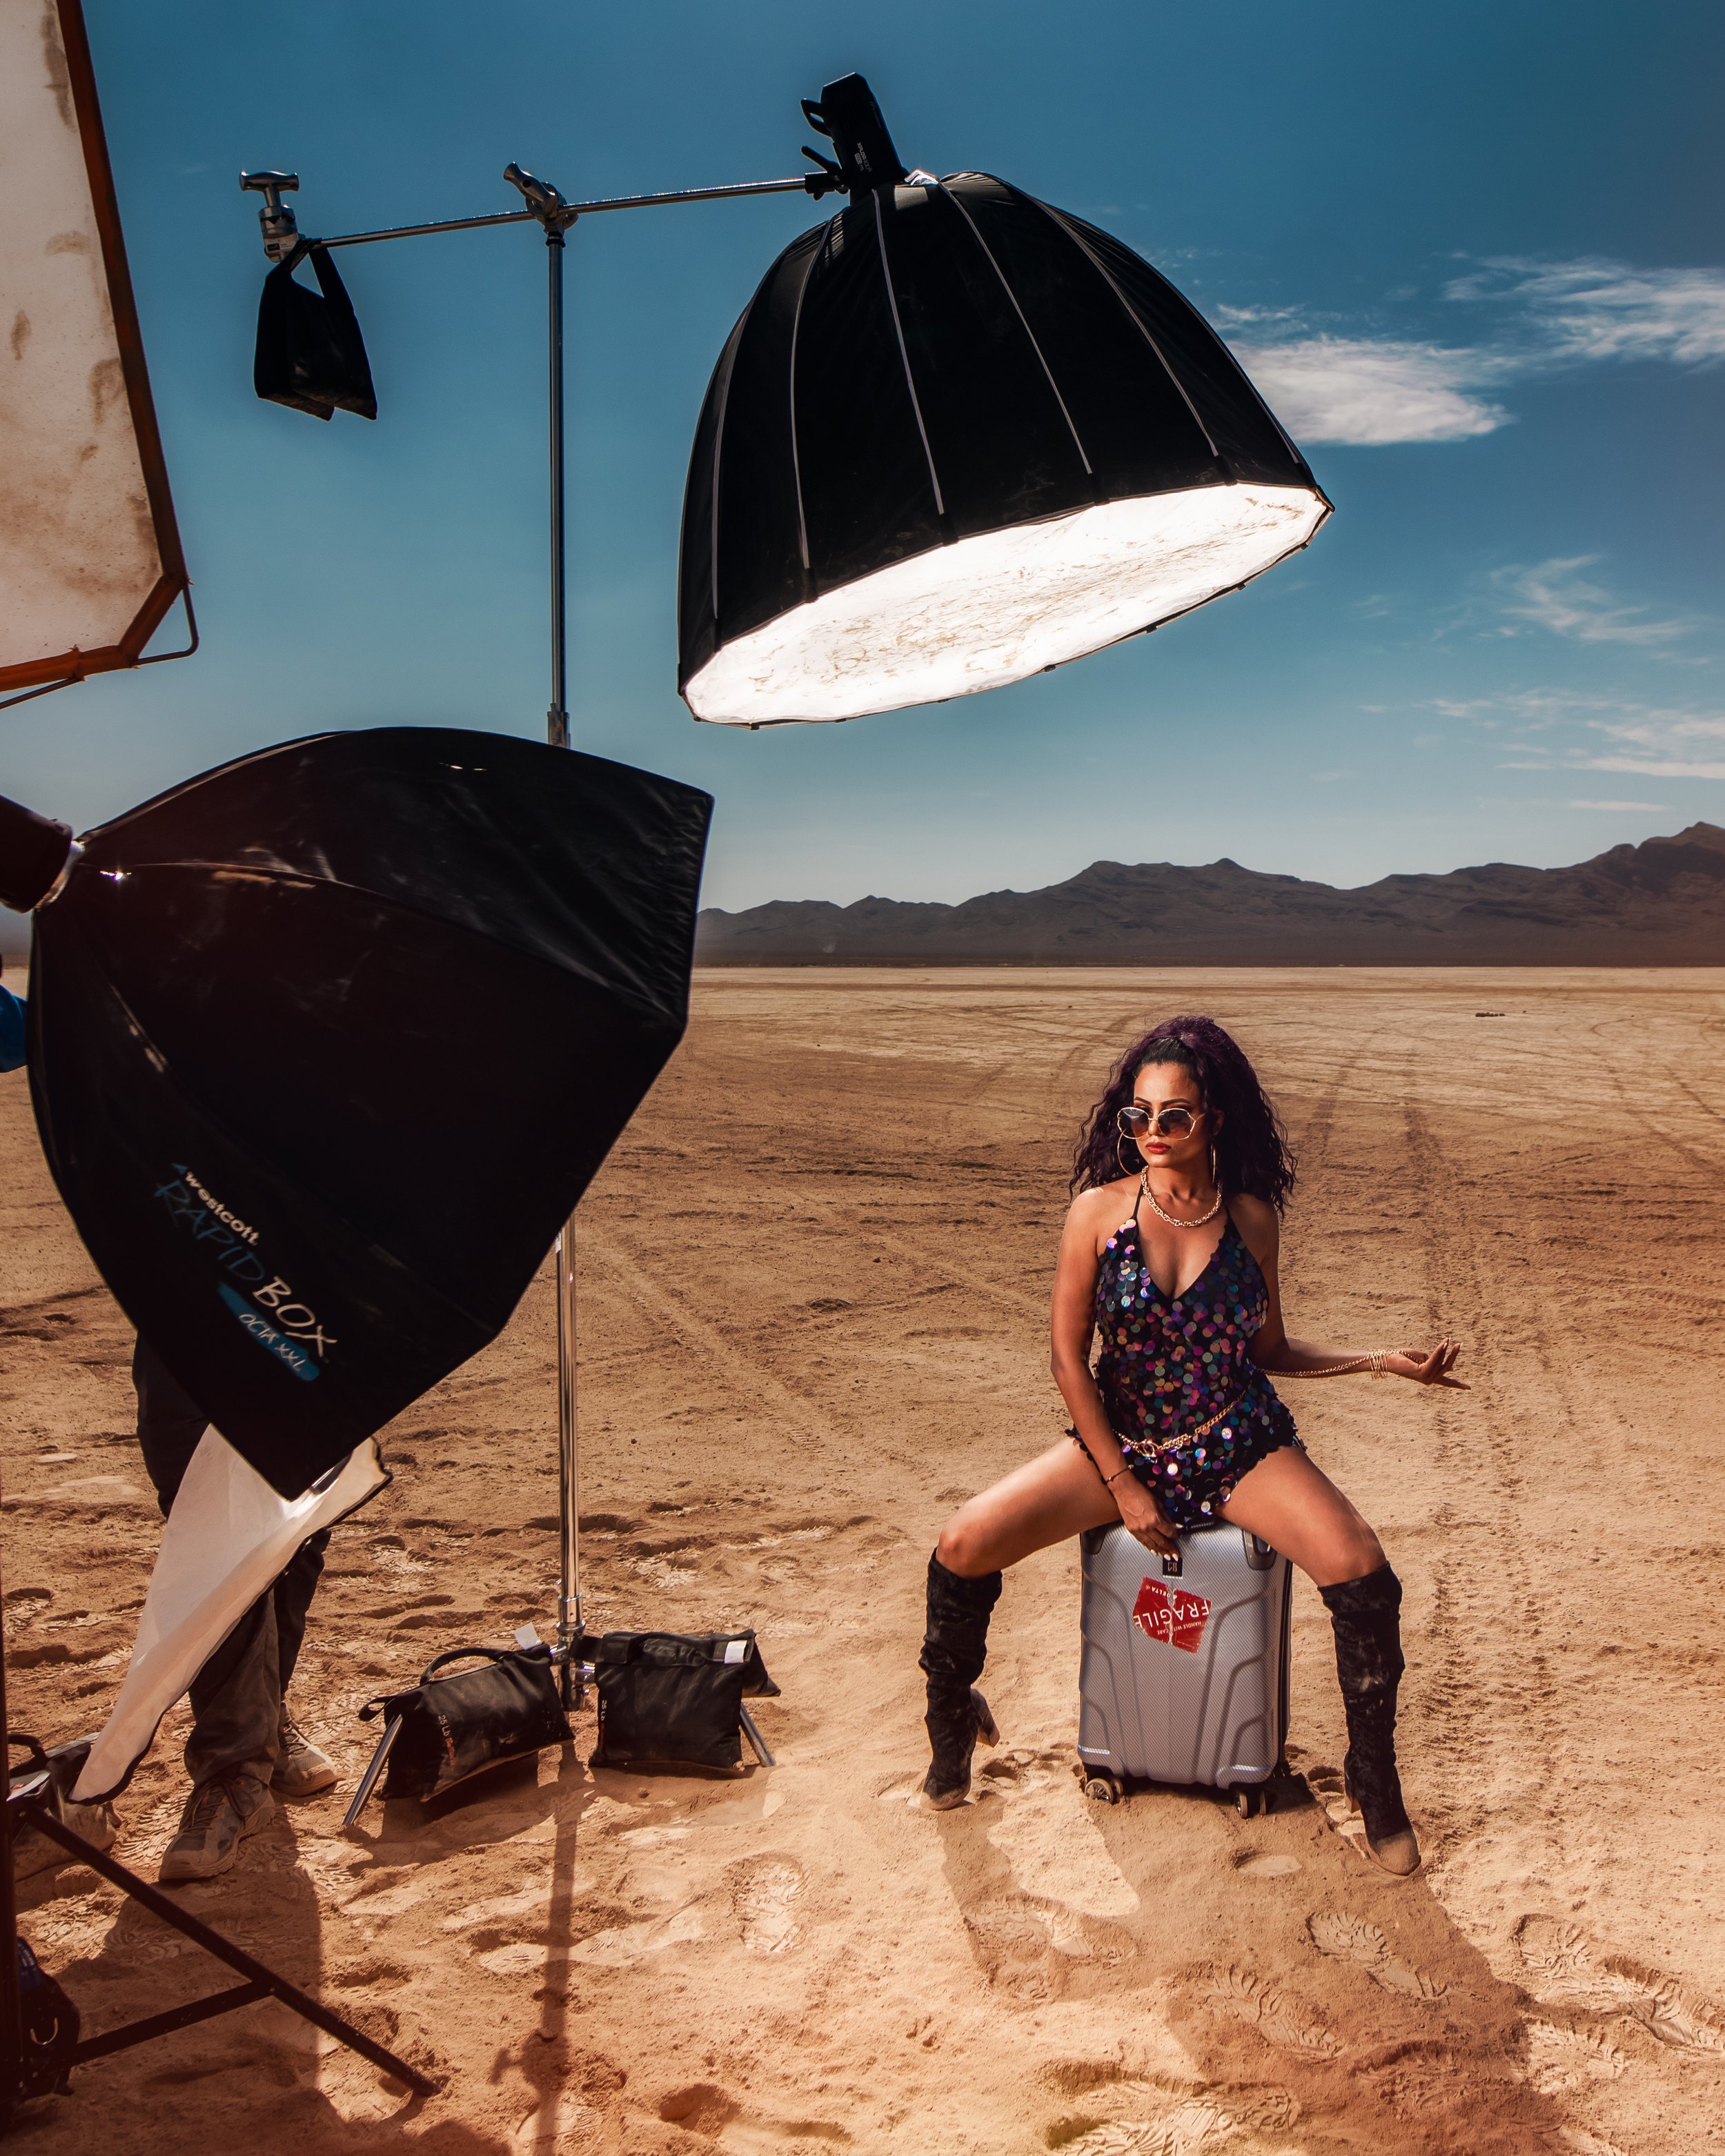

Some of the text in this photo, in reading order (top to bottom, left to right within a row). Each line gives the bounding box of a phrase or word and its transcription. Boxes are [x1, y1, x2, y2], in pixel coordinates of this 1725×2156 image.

[185, 1171, 260, 1245] westcott
[239, 1313, 306, 1372] OCTA XXL
[1152, 1586, 1171, 1598] DELTA
[1133, 1600, 1210, 1629] FRAGILE
[1183, 1621, 1201, 1630] HANDLE
[438, 1714, 448, 1725] 25
